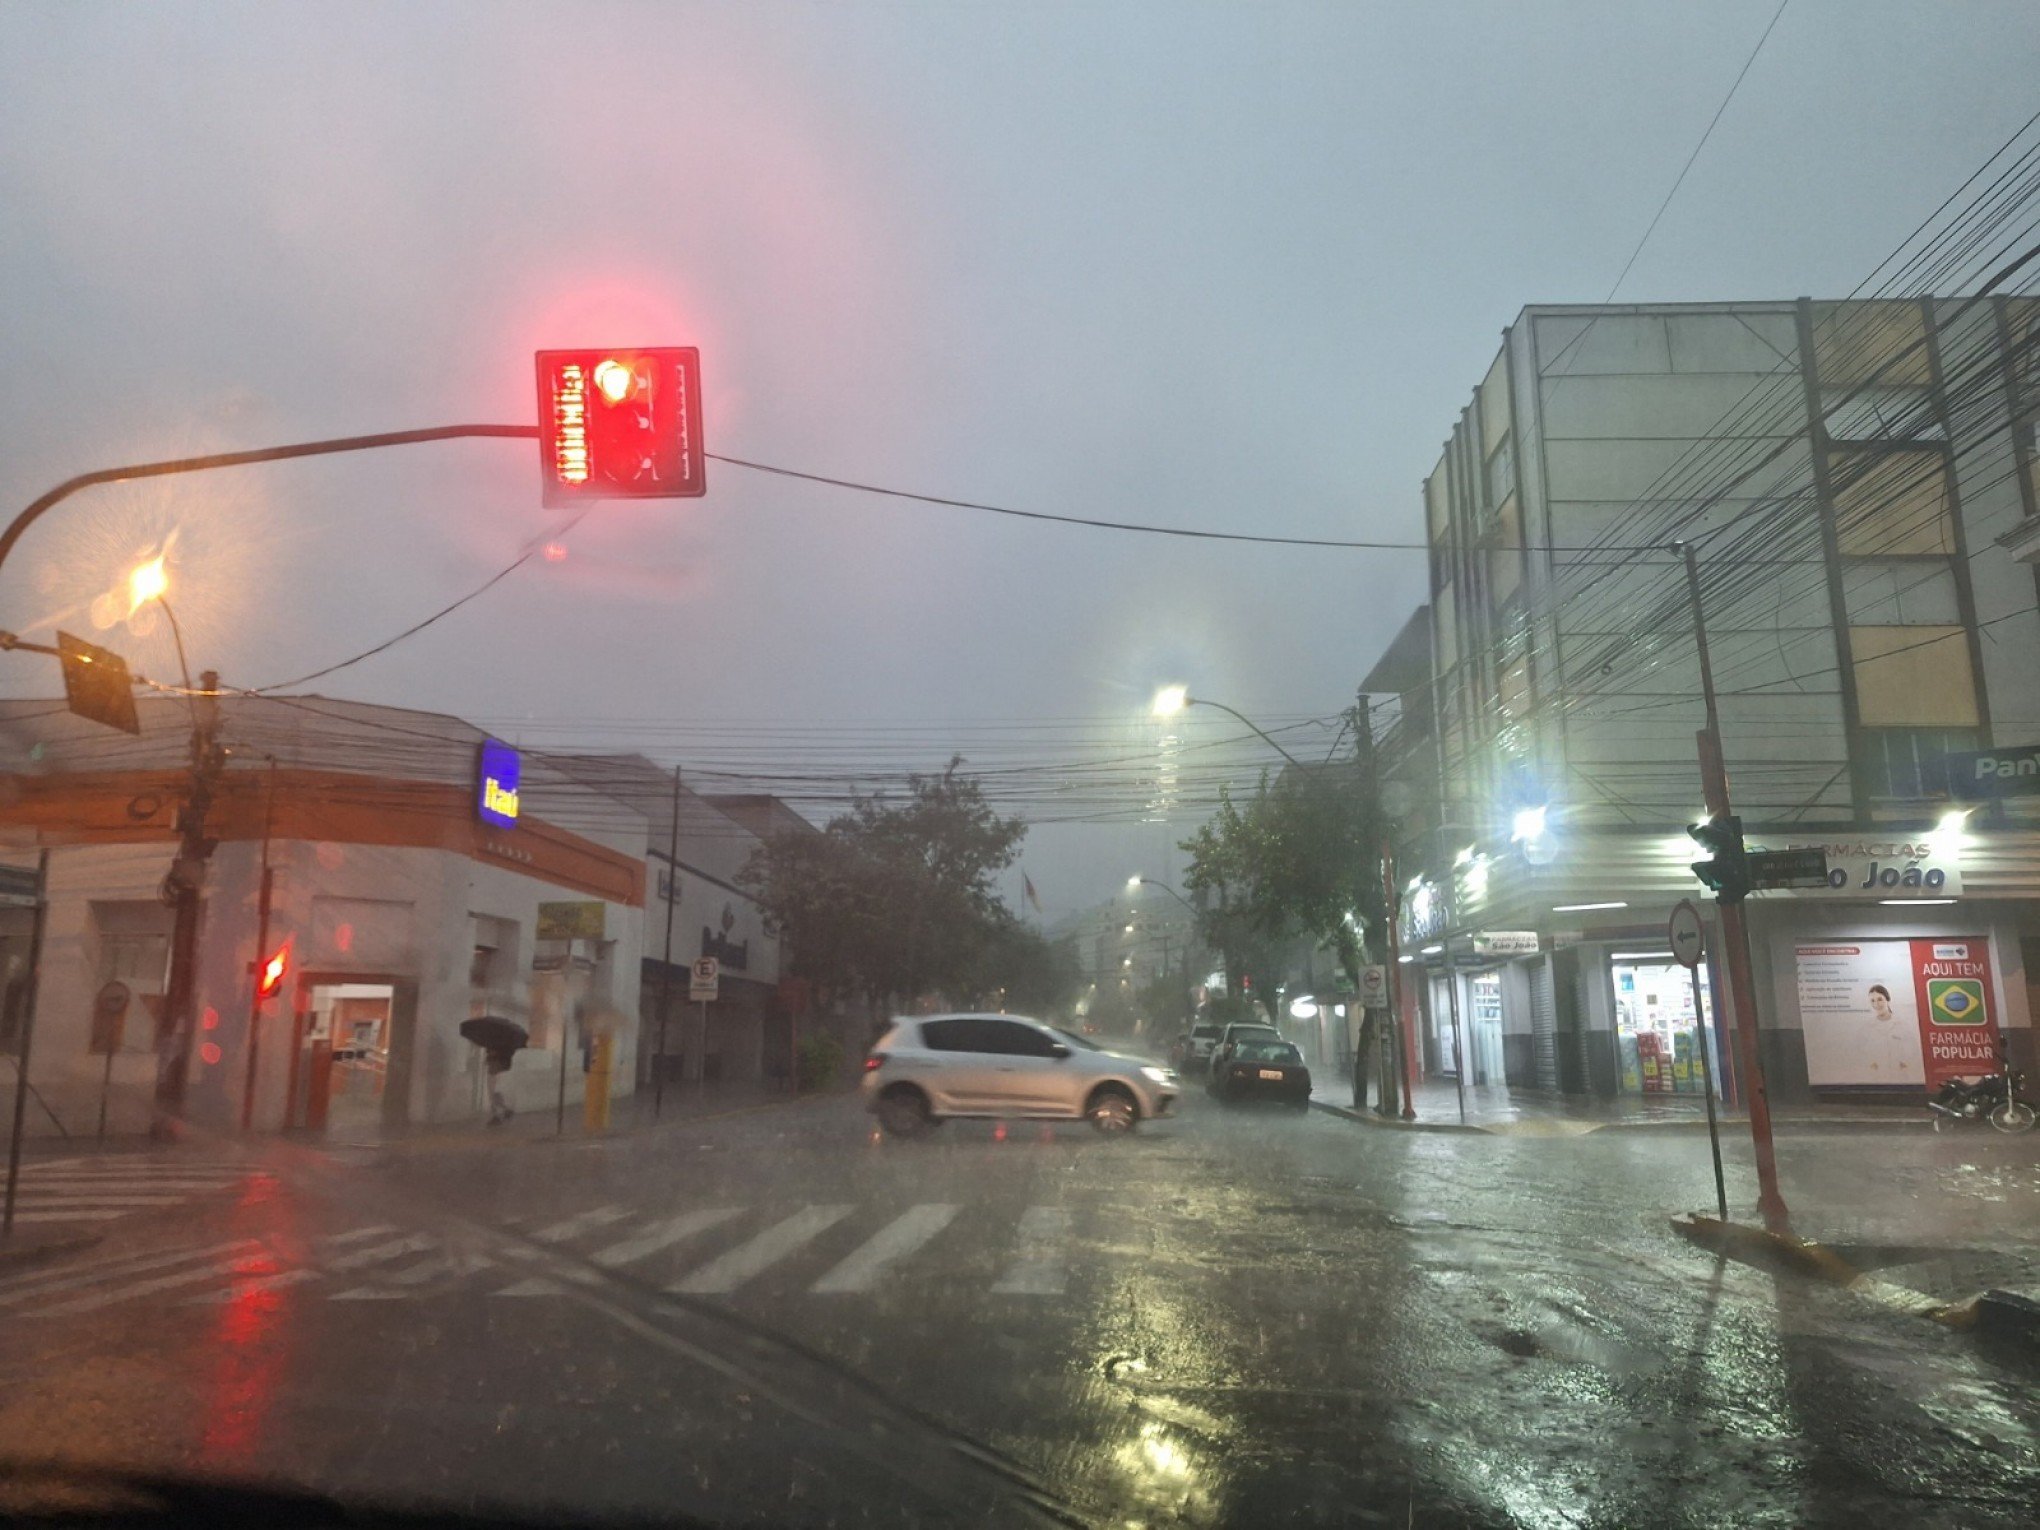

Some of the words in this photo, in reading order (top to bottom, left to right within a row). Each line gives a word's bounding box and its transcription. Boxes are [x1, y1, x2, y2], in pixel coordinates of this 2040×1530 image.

[1859, 860, 1945, 889] João
[1923, 963, 1953, 976] AQUI
[1956, 962, 1985, 976] TEM
[1930, 1030, 1993, 1046] FARMÁCIA
[1933, 1046, 1994, 1059] POPULAR
